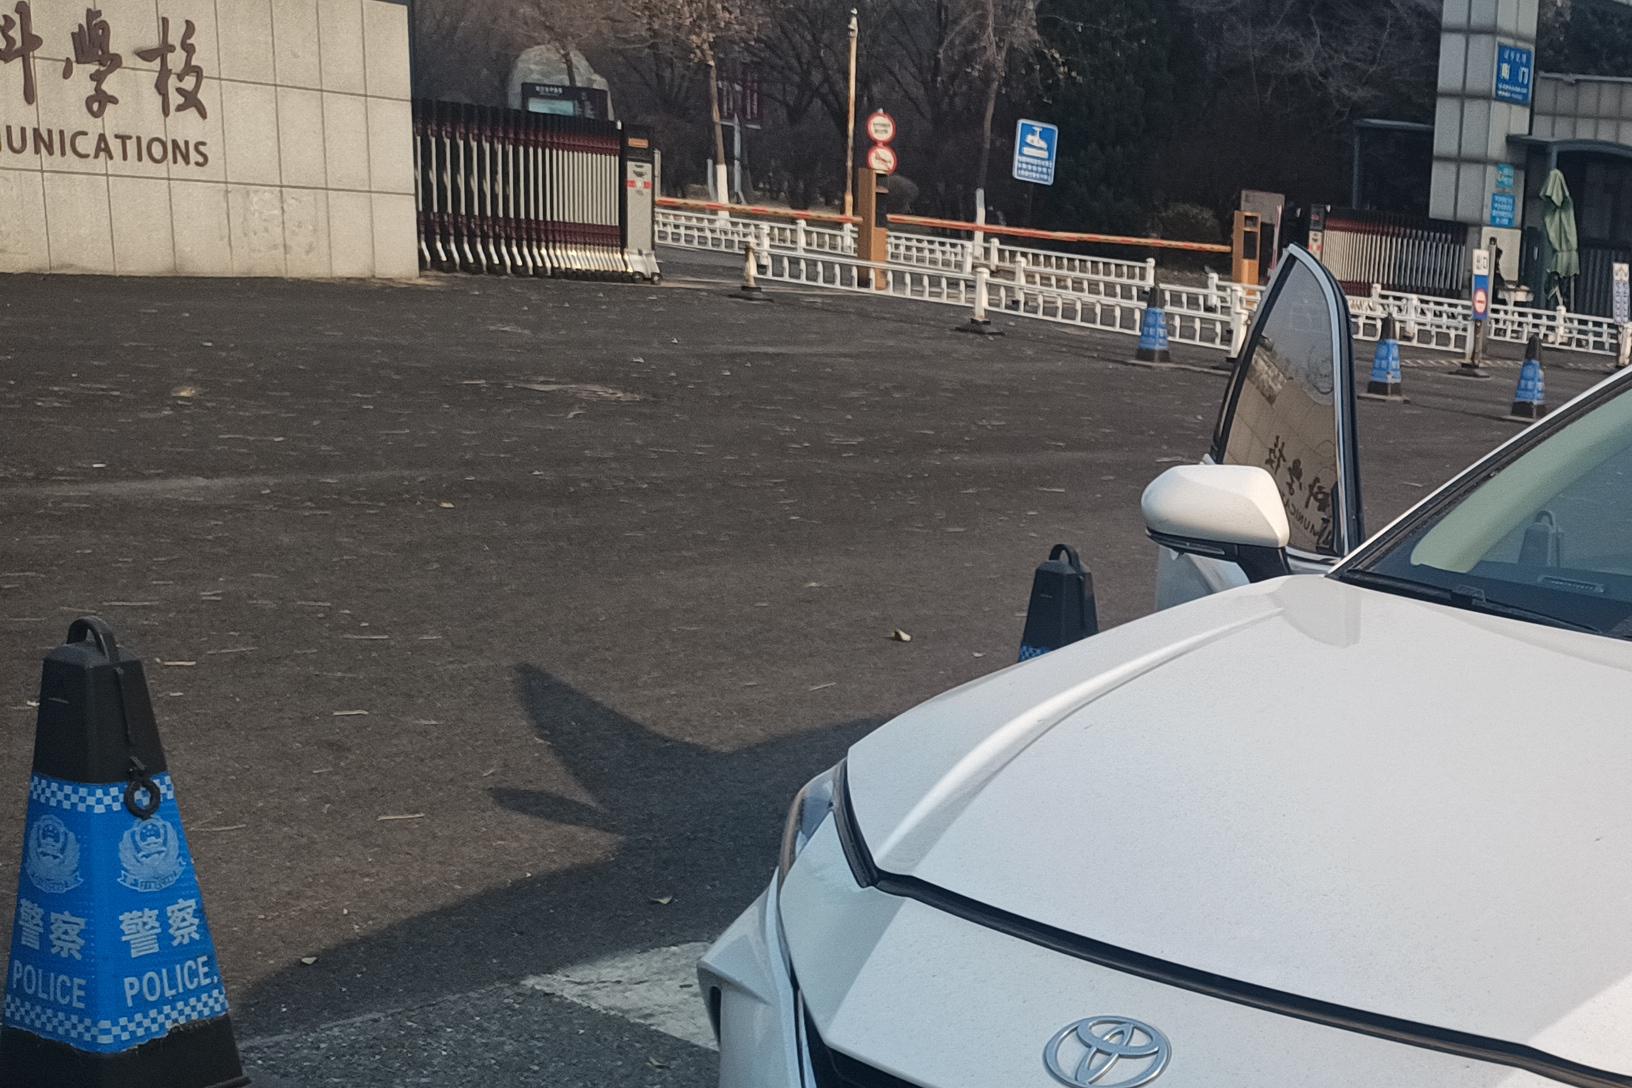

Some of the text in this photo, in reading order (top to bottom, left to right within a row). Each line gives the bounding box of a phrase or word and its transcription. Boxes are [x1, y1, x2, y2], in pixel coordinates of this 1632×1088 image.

[0, 124, 209, 168] UNICATIONS
[18, 897, 88, 961] 警察
[119, 898, 200, 959] 警察
[12, 959, 88, 1009] POLICE
[123, 955, 212, 1008] POLICE
